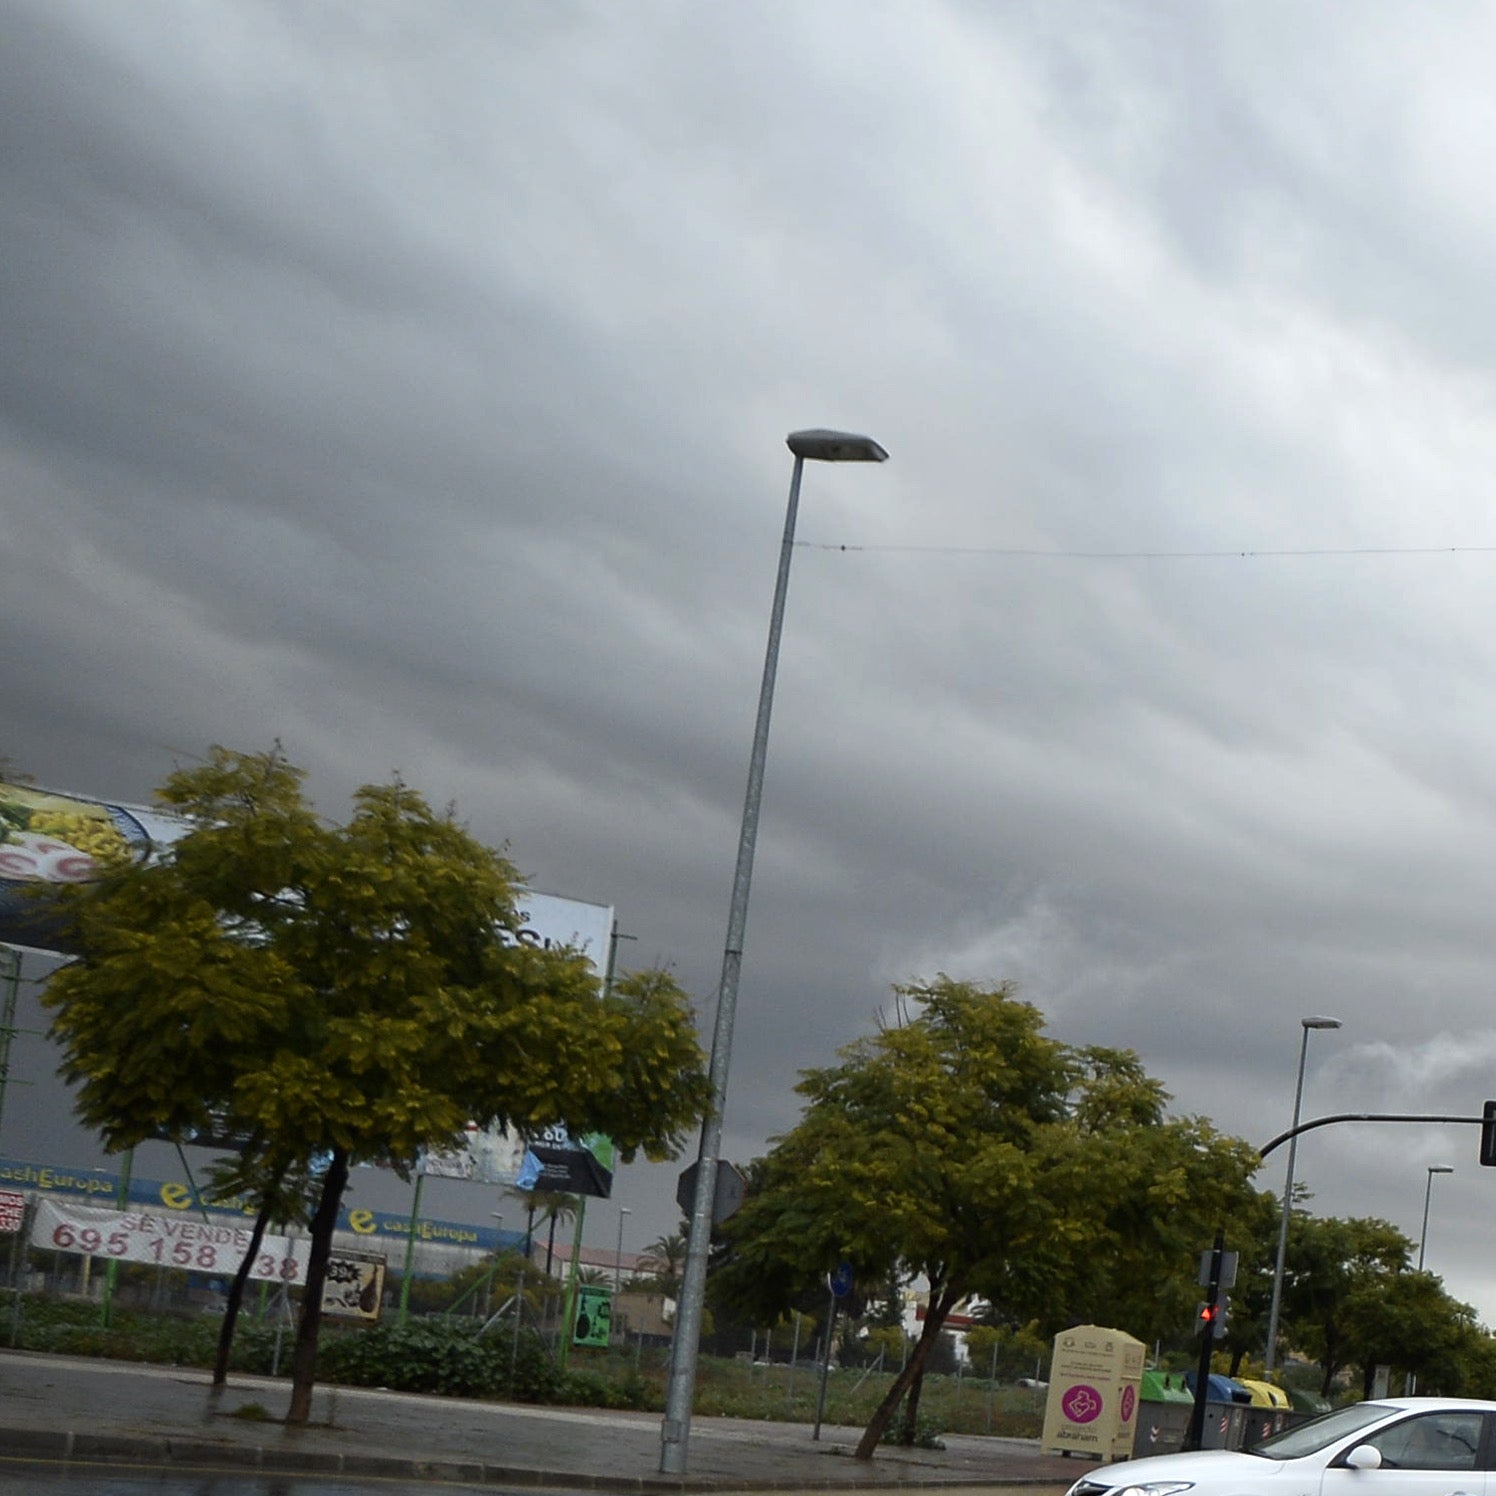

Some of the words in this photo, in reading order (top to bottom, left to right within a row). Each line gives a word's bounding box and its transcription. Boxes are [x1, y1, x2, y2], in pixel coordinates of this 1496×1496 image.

[53, 1223, 129, 1256] 695
[149, 1237, 217, 1268] 158
[238, 1250, 300, 1281] 38
[119, 1213, 156, 1234] SE
[164, 1219, 248, 1247] VENDE
